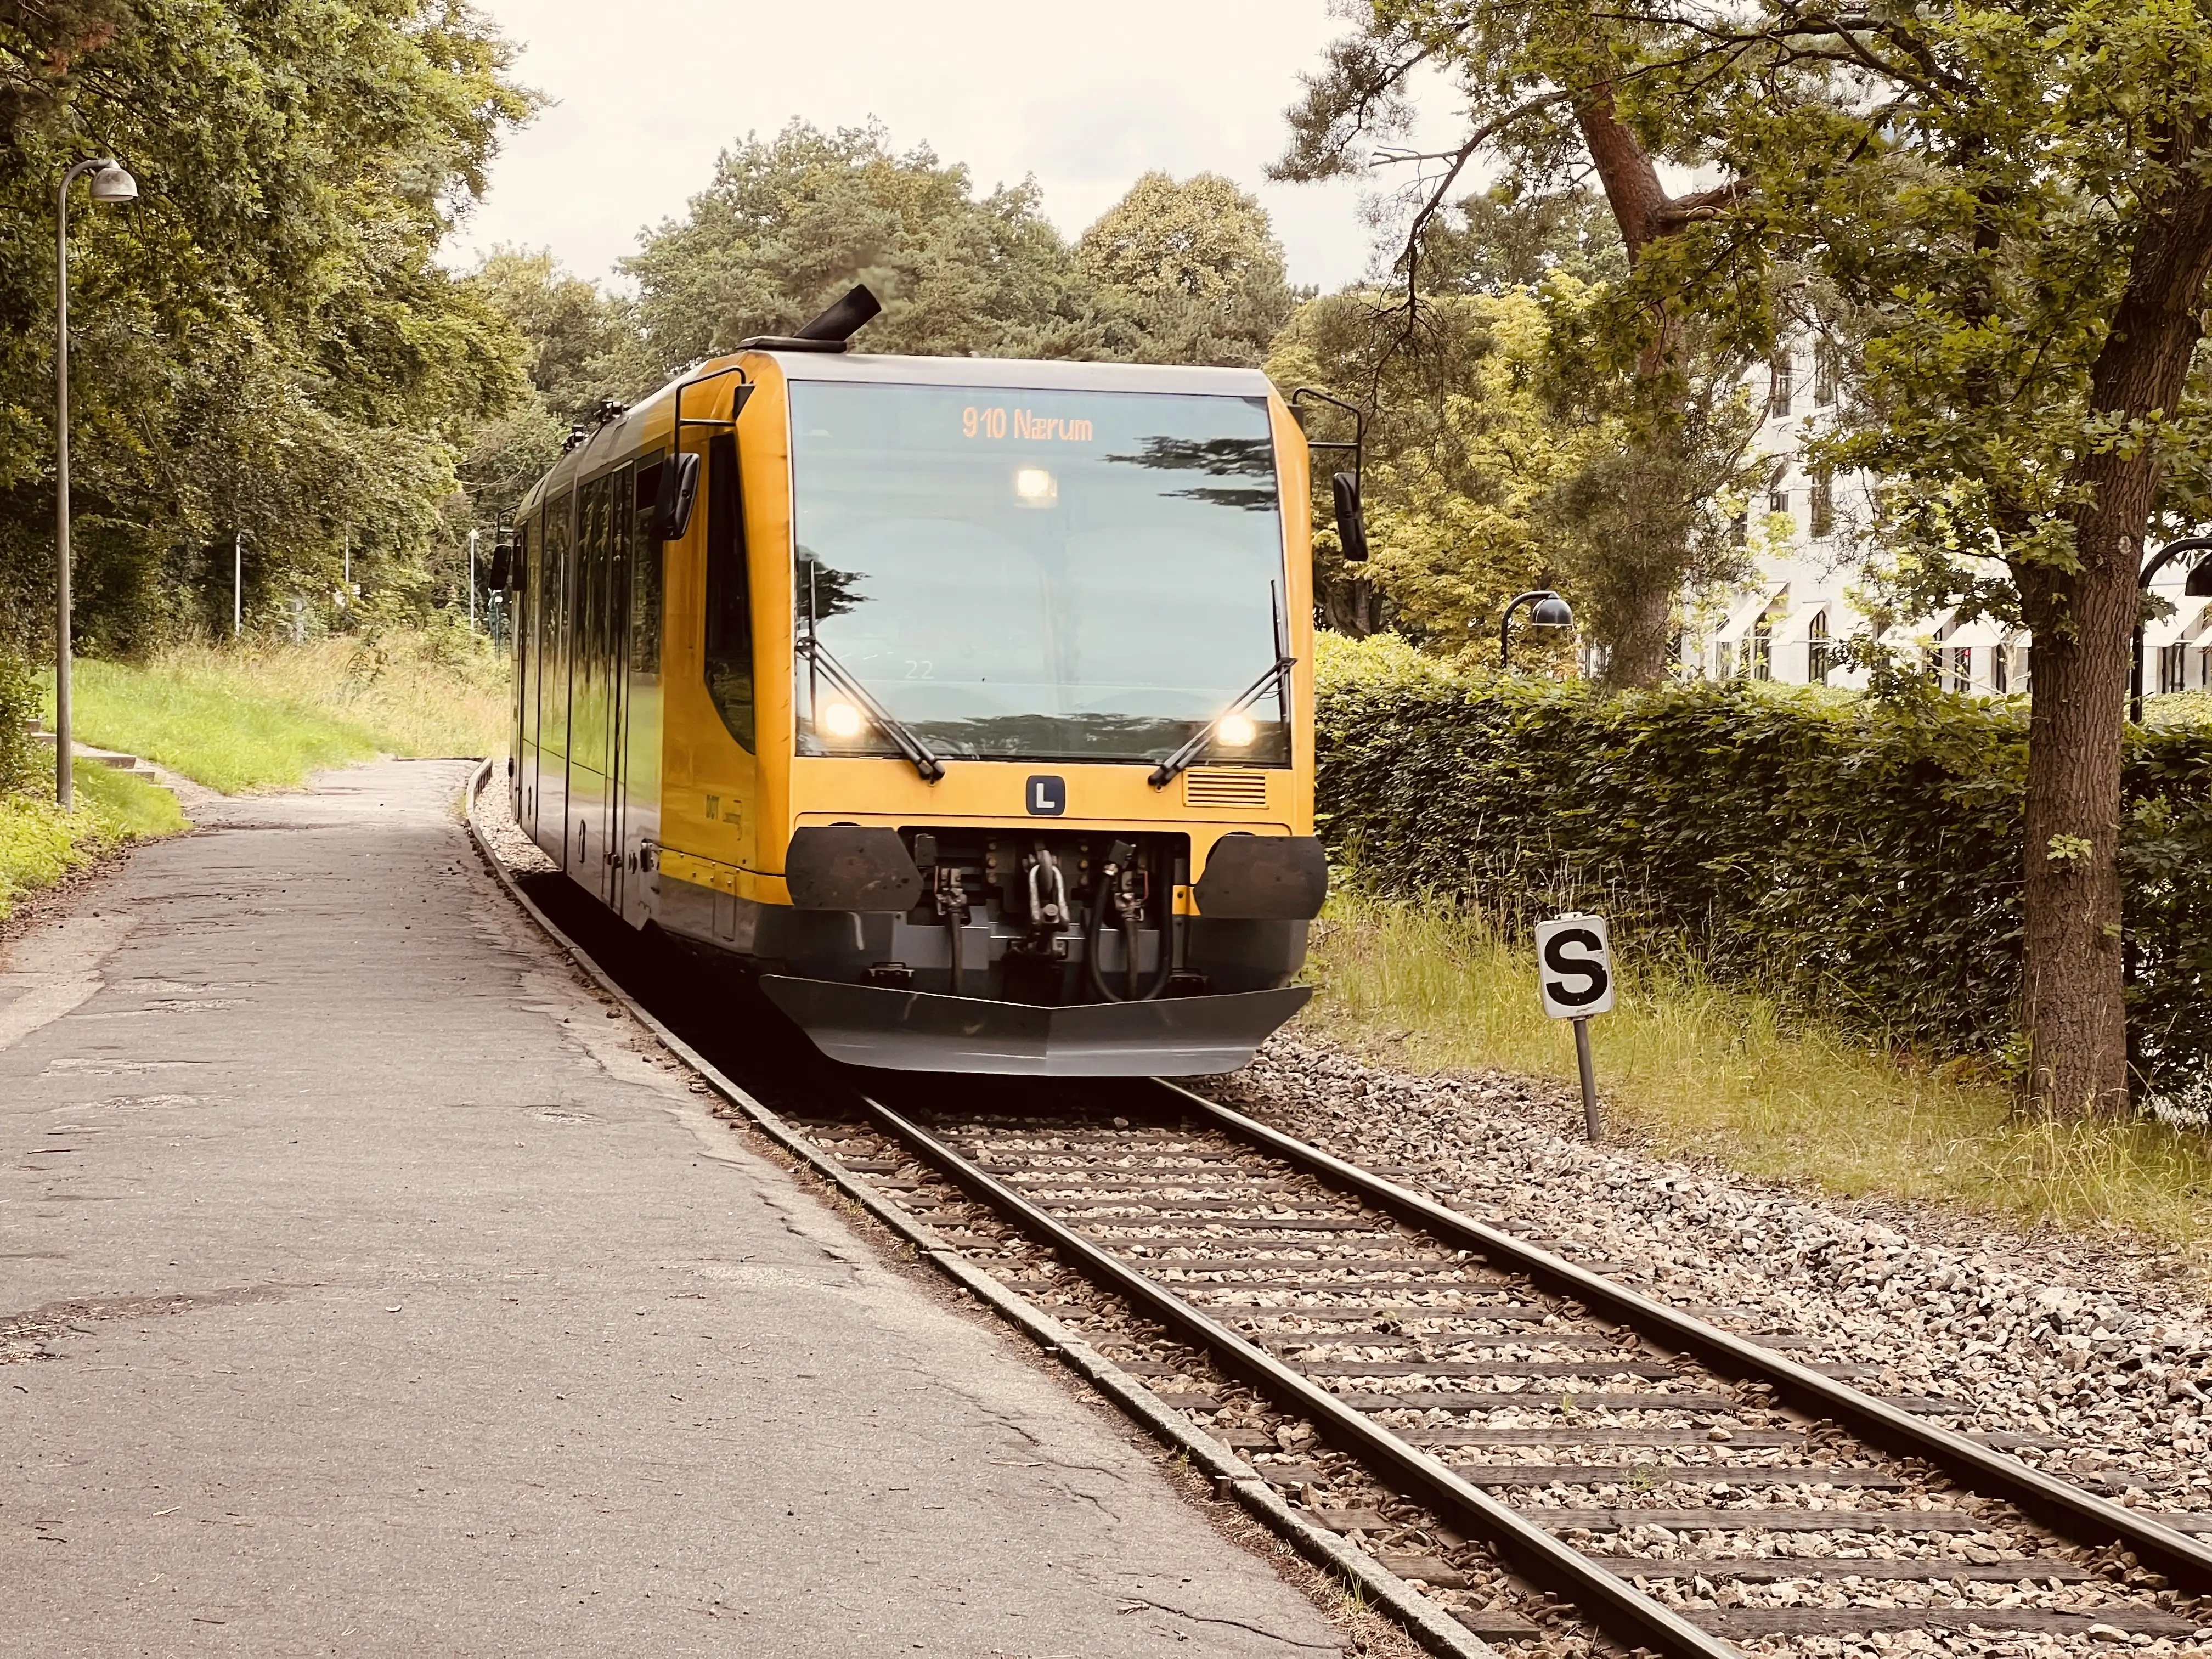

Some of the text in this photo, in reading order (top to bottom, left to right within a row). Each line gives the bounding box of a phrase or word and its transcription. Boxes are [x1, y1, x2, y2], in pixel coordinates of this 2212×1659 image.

[963, 407, 1093, 441] 910 Nærum
[905, 659, 935, 679] 22
[1036, 783, 1056, 808] L
[1544, 928, 1608, 1006] S
